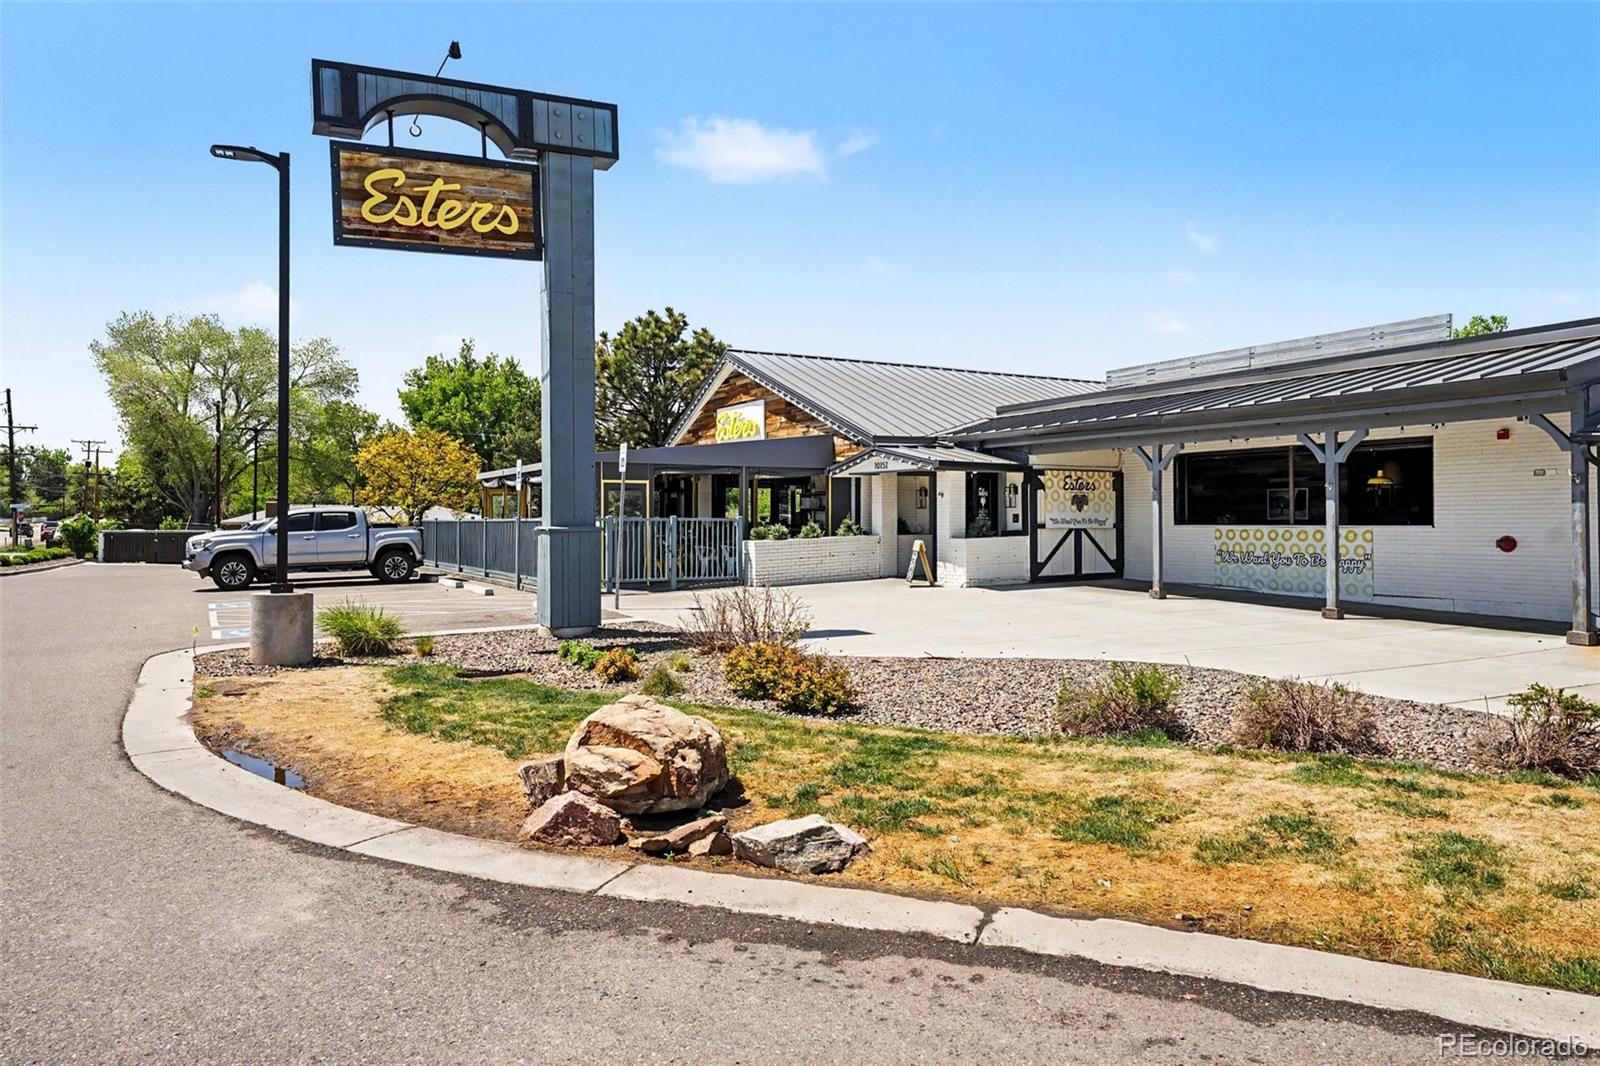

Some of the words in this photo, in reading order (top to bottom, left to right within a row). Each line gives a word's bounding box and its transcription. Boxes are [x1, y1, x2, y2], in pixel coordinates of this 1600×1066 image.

[361, 168, 519, 235] Esters
[1063, 475, 1096, 491] Esters
[1240, 551, 1270, 565] Want
[1270, 552, 1293, 569] You
[1293, 553, 1309, 566] To
[1309, 553, 1327, 567] Be
[1339, 553, 1372, 574] appy"
